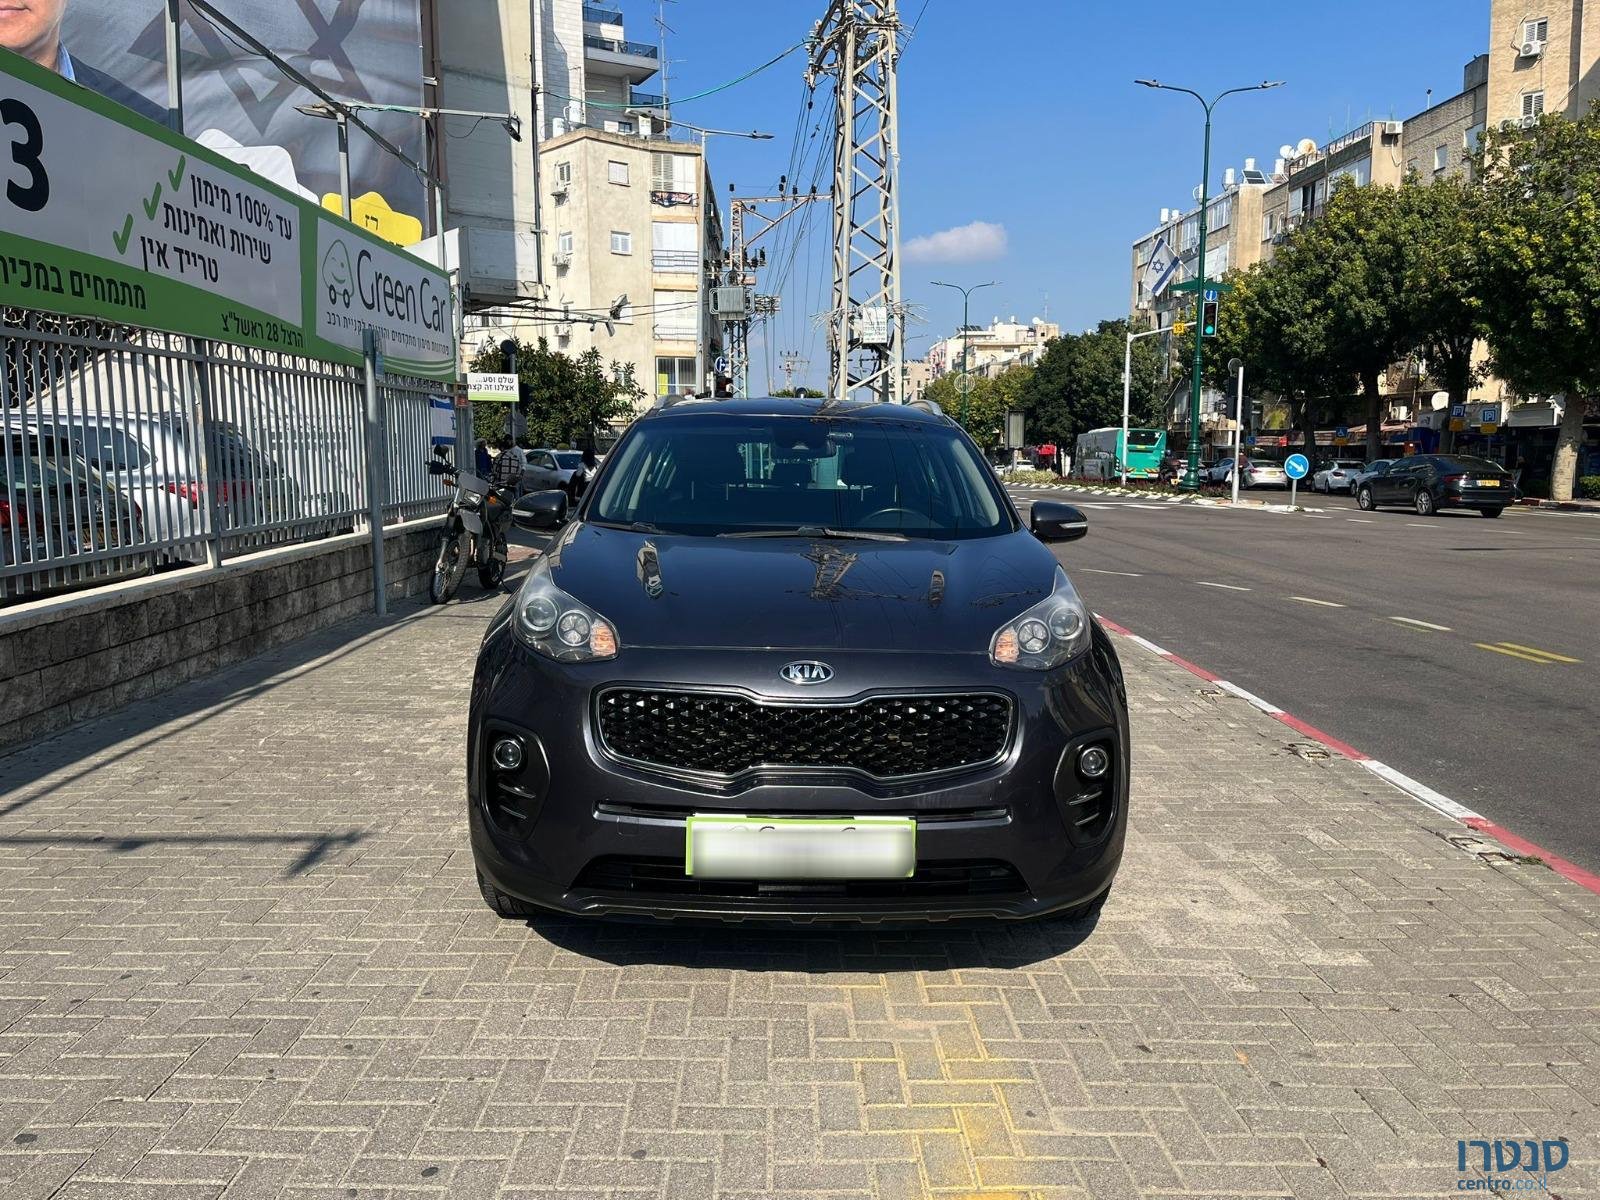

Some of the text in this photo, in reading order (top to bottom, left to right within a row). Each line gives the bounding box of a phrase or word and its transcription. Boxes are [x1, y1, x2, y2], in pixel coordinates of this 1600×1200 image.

[0, 98, 49, 212] 3
[190, 174, 292, 240] עד 100% מימון
[163, 202, 272, 265] שירות ואמינות
[140, 236, 219, 283] טרייד אין
[69, 270, 147, 310] מתמחים
[357, 249, 446, 334] Green Car
[265, 322, 279, 342] 28
[280, 324, 304, 348] הרצל
[326, 311, 341, 327] רכב
[497, 376, 514, 384] שלם
[789, 665, 826, 679] KIA
